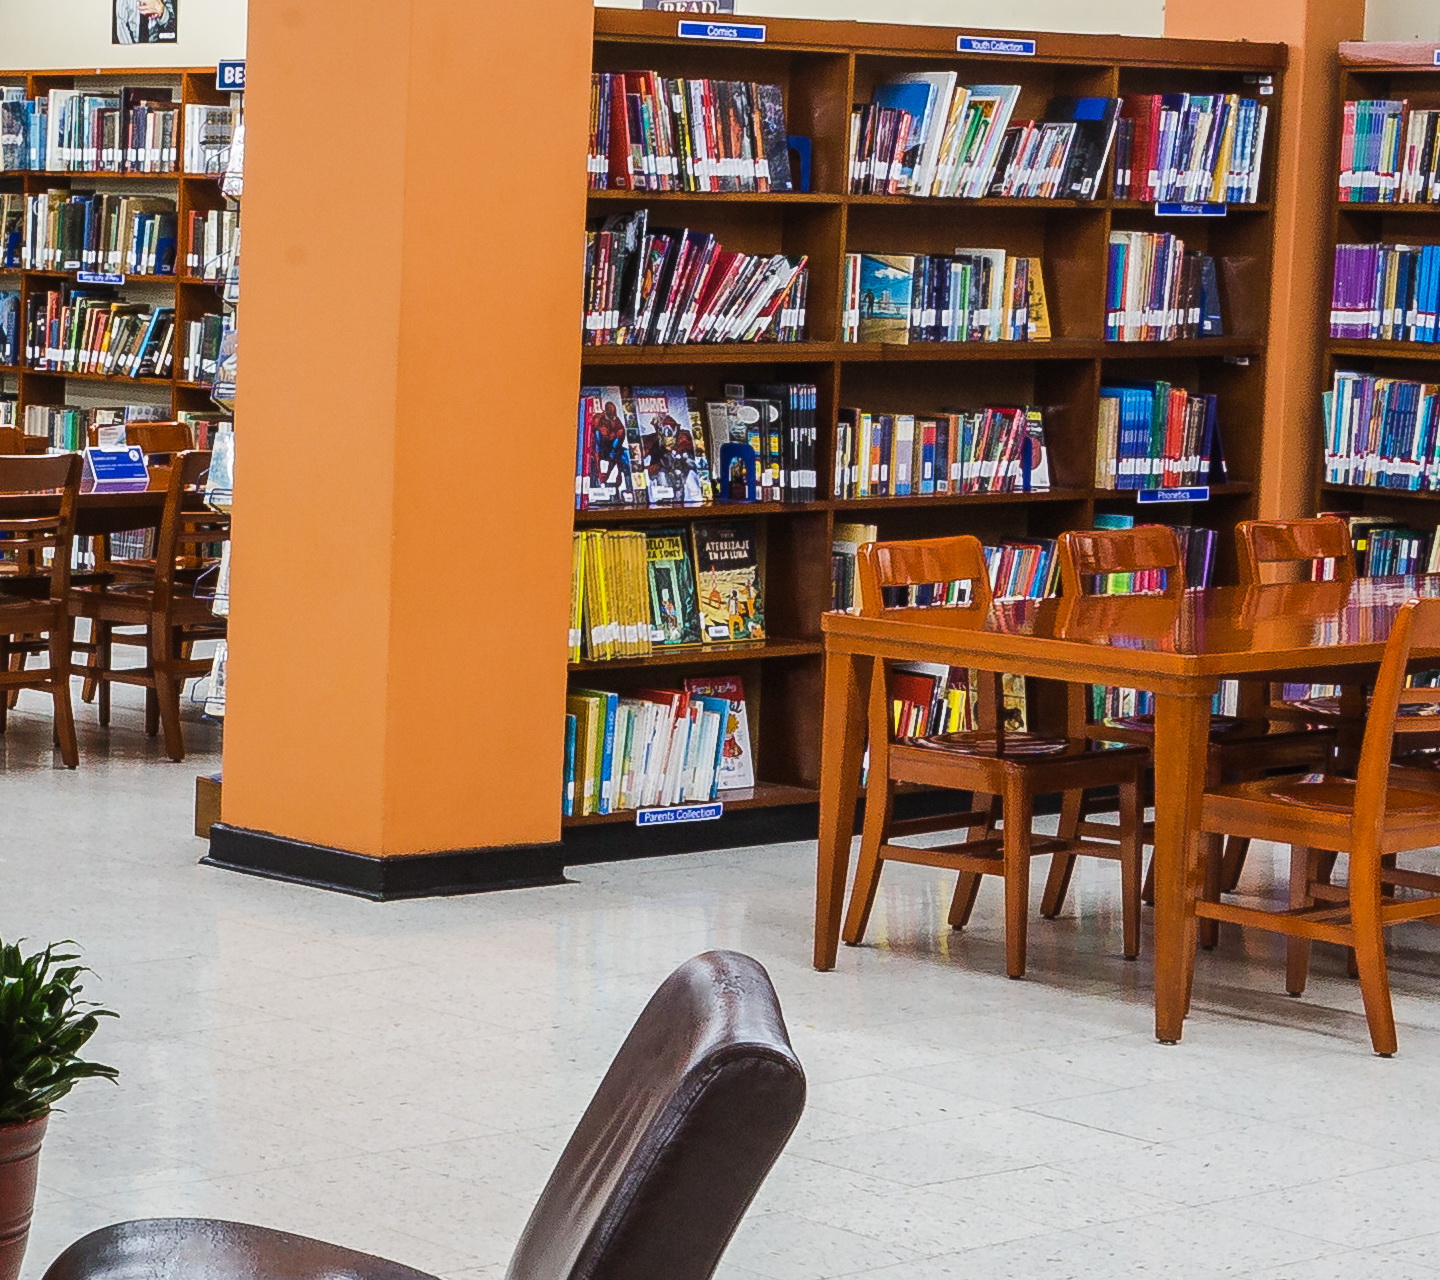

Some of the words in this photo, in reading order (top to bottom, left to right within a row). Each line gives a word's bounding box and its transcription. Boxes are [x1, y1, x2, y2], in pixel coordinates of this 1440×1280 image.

[707, 25, 738, 38] Comics
[971, 40, 990, 50] Youth
[991, 40, 1024, 52] Collection
[638, 397, 669, 413] MARVEL
[1157, 490, 1191, 500] Phonetics
[705, 540, 750, 551] ATERRIZAJE
[720, 551, 729, 560] LA
[644, 810, 675, 823] Parents
[676, 807, 716, 821] Collection
